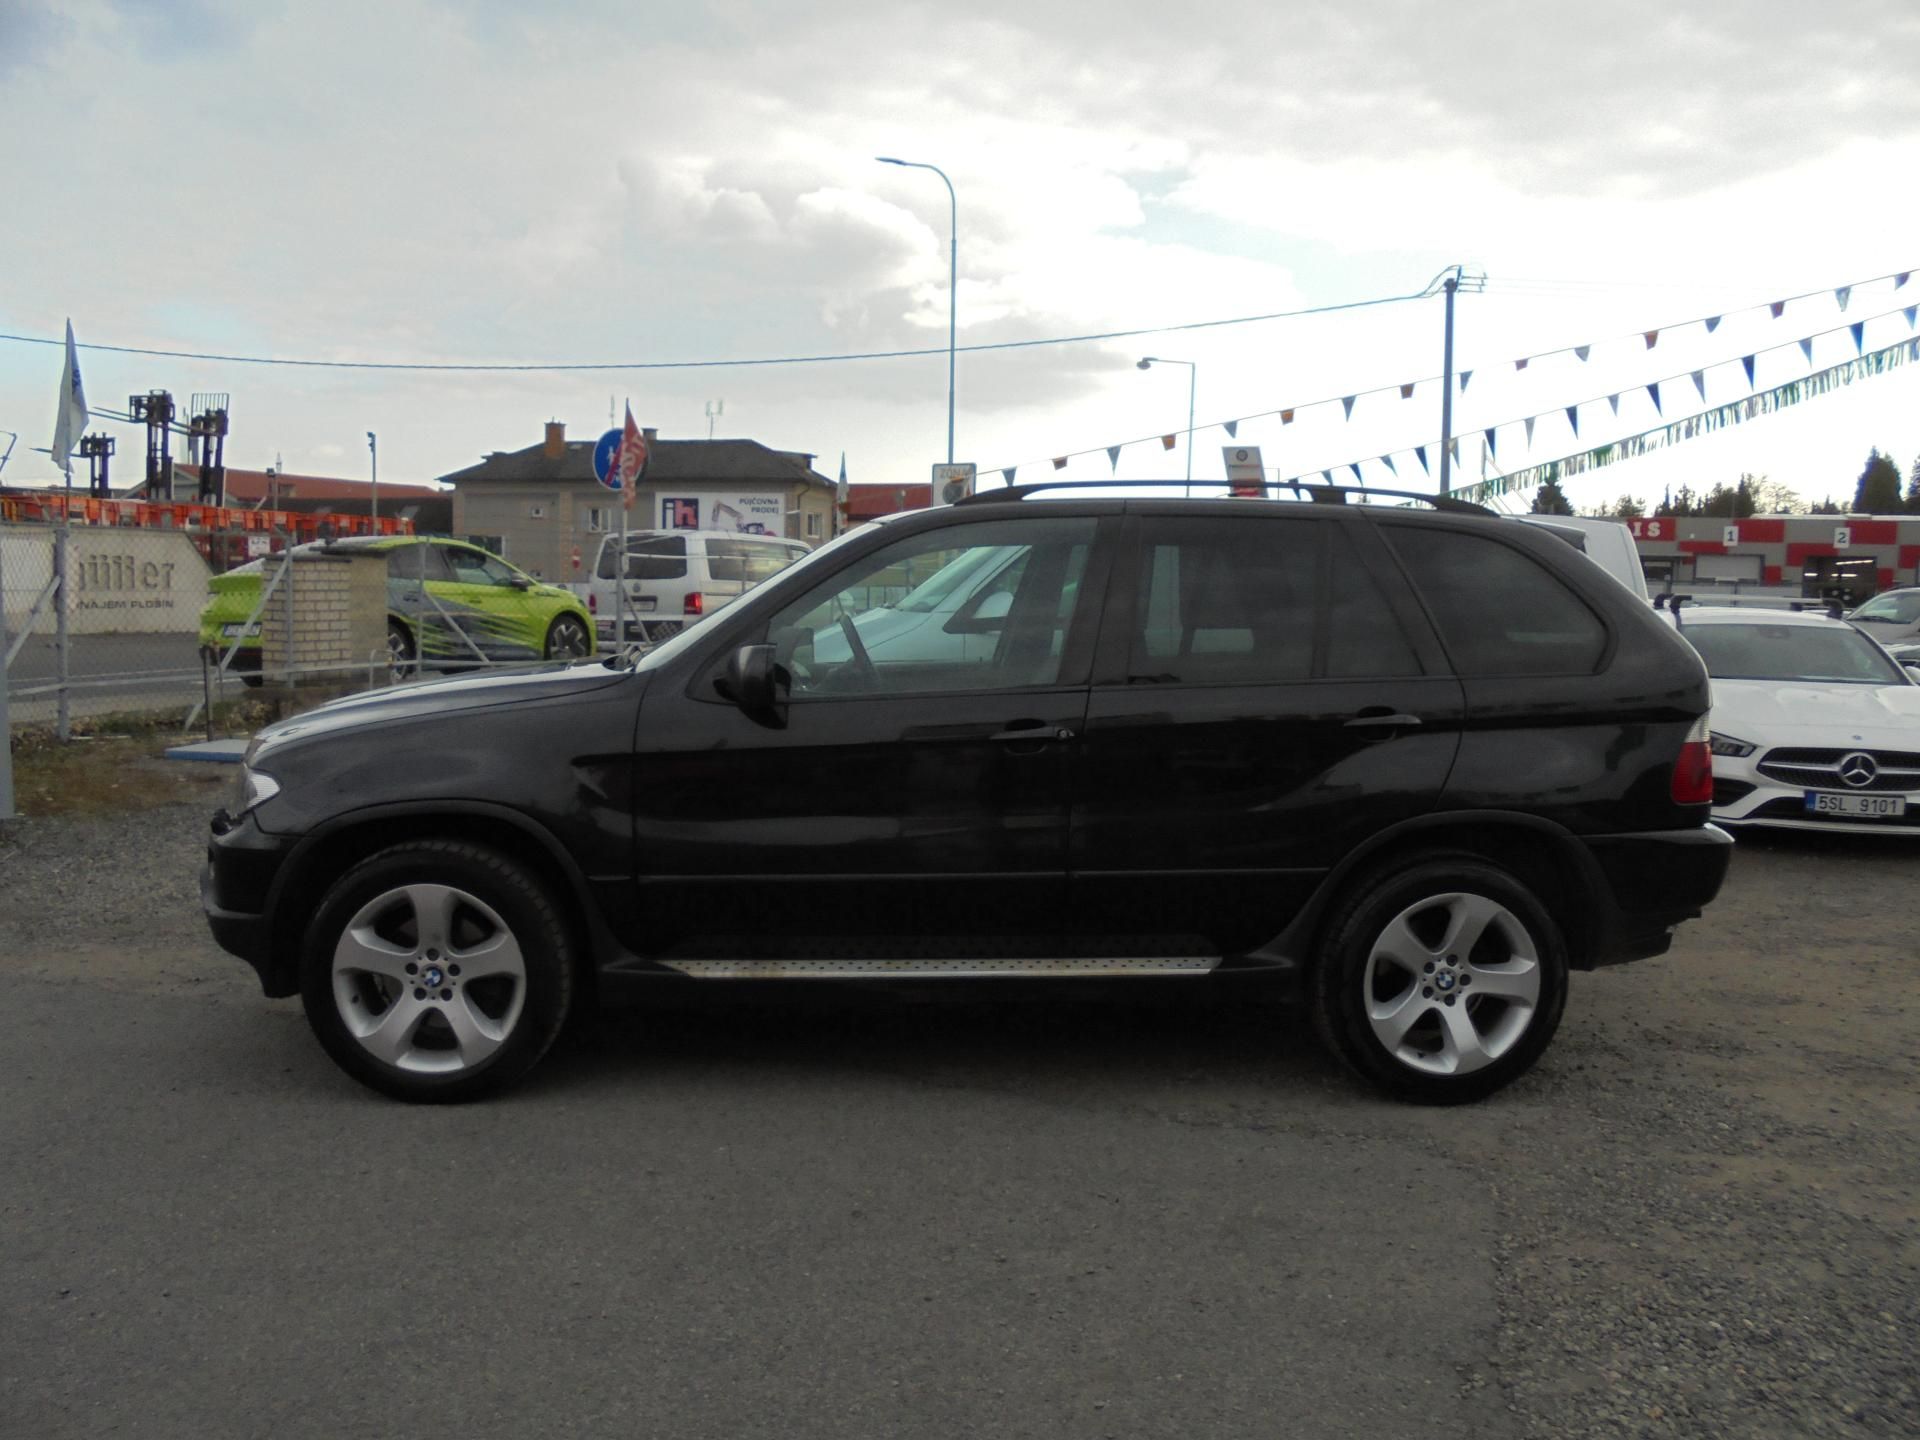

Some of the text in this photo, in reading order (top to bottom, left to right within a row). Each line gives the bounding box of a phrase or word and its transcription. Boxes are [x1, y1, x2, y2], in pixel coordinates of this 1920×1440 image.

[1727, 531, 1734, 542] 1
[1837, 532, 1847, 544] 2
[1819, 796, 1847, 811] 5SL
[1860, 799, 1897, 813] 9101
